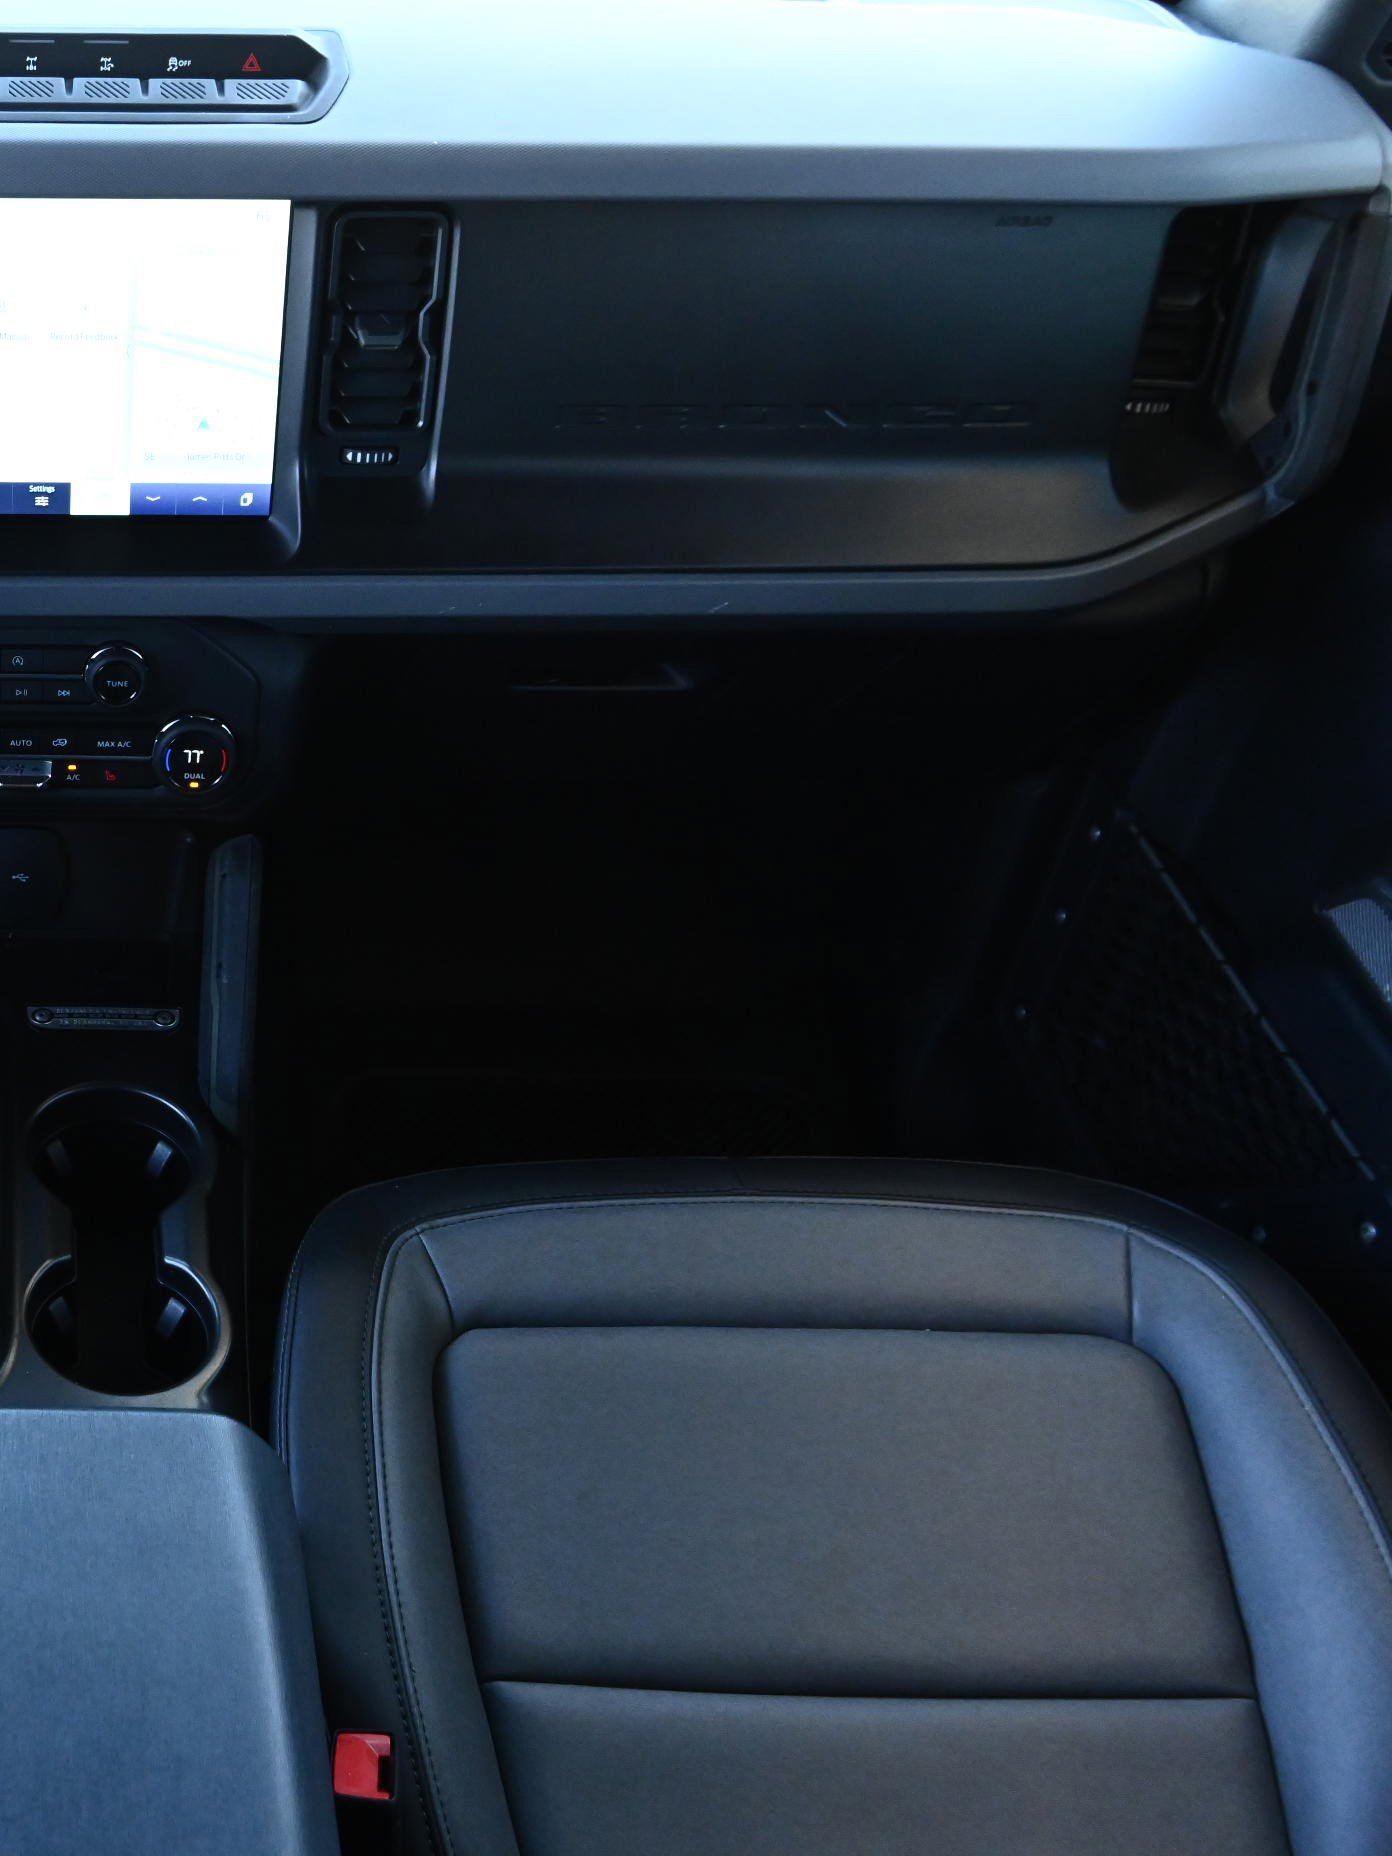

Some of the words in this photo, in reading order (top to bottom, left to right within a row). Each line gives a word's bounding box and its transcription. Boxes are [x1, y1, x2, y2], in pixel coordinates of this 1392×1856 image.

[178, 59, 192, 67] OFF
[28, 484, 56, 494] Settings
[106, 680, 129, 688] TUNE
[10, 739, 33, 747] AUTO
[97, 740, 116, 748] MAX
[117, 740, 133, 748] A/C
[183, 772, 206, 780] DUAL
